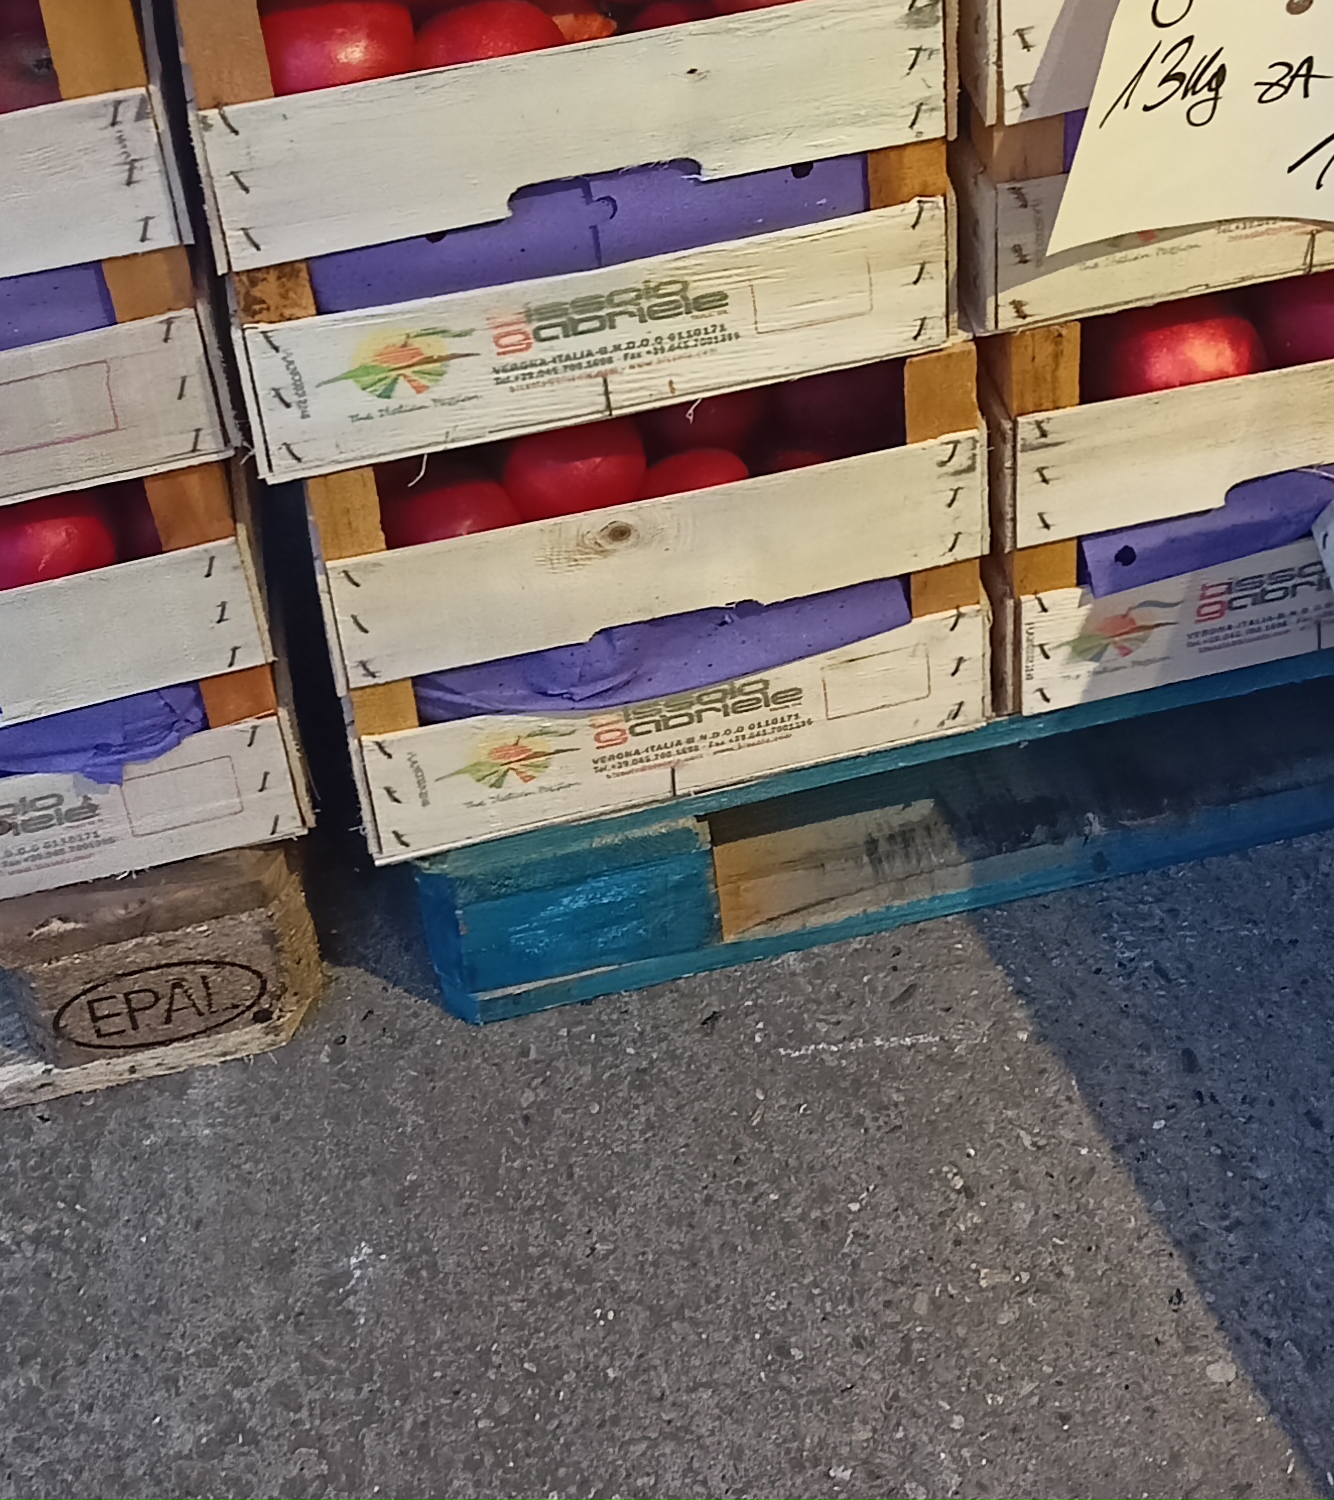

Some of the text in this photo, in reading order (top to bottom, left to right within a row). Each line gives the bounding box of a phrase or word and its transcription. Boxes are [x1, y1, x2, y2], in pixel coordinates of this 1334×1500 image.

[1255, 55, 1333, 104] ZA
[493, 290, 730, 357] gabriele
[593, 686, 804, 750] gabriele
[86, 974, 239, 1041] EPAL
